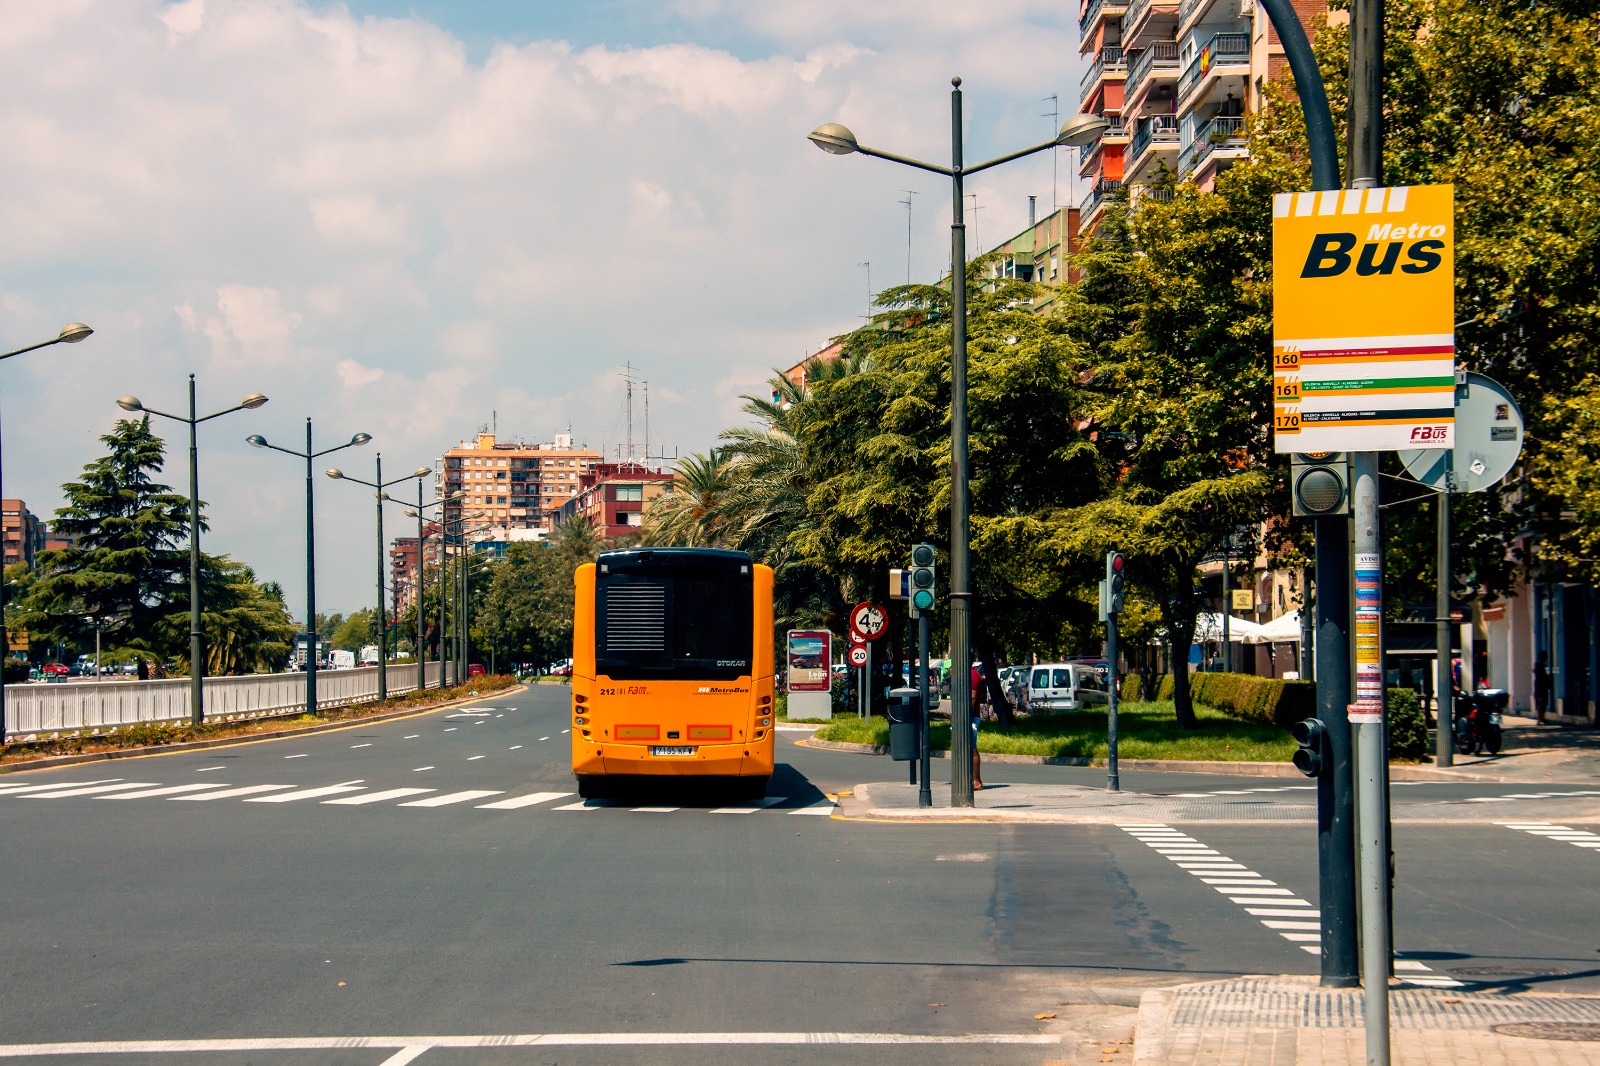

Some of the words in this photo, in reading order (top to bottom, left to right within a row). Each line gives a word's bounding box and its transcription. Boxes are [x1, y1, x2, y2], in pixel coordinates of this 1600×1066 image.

[1366, 222, 1446, 241] Metro
[1300, 232, 1446, 279] Bus
[1275, 354, 1298, 365] 160
[1276, 385, 1298, 396] 161
[1276, 416, 1299, 427] 170
[854, 652, 866, 660] 20
[600, 688, 616, 696] 212
[657, 747, 676, 755] 7195
